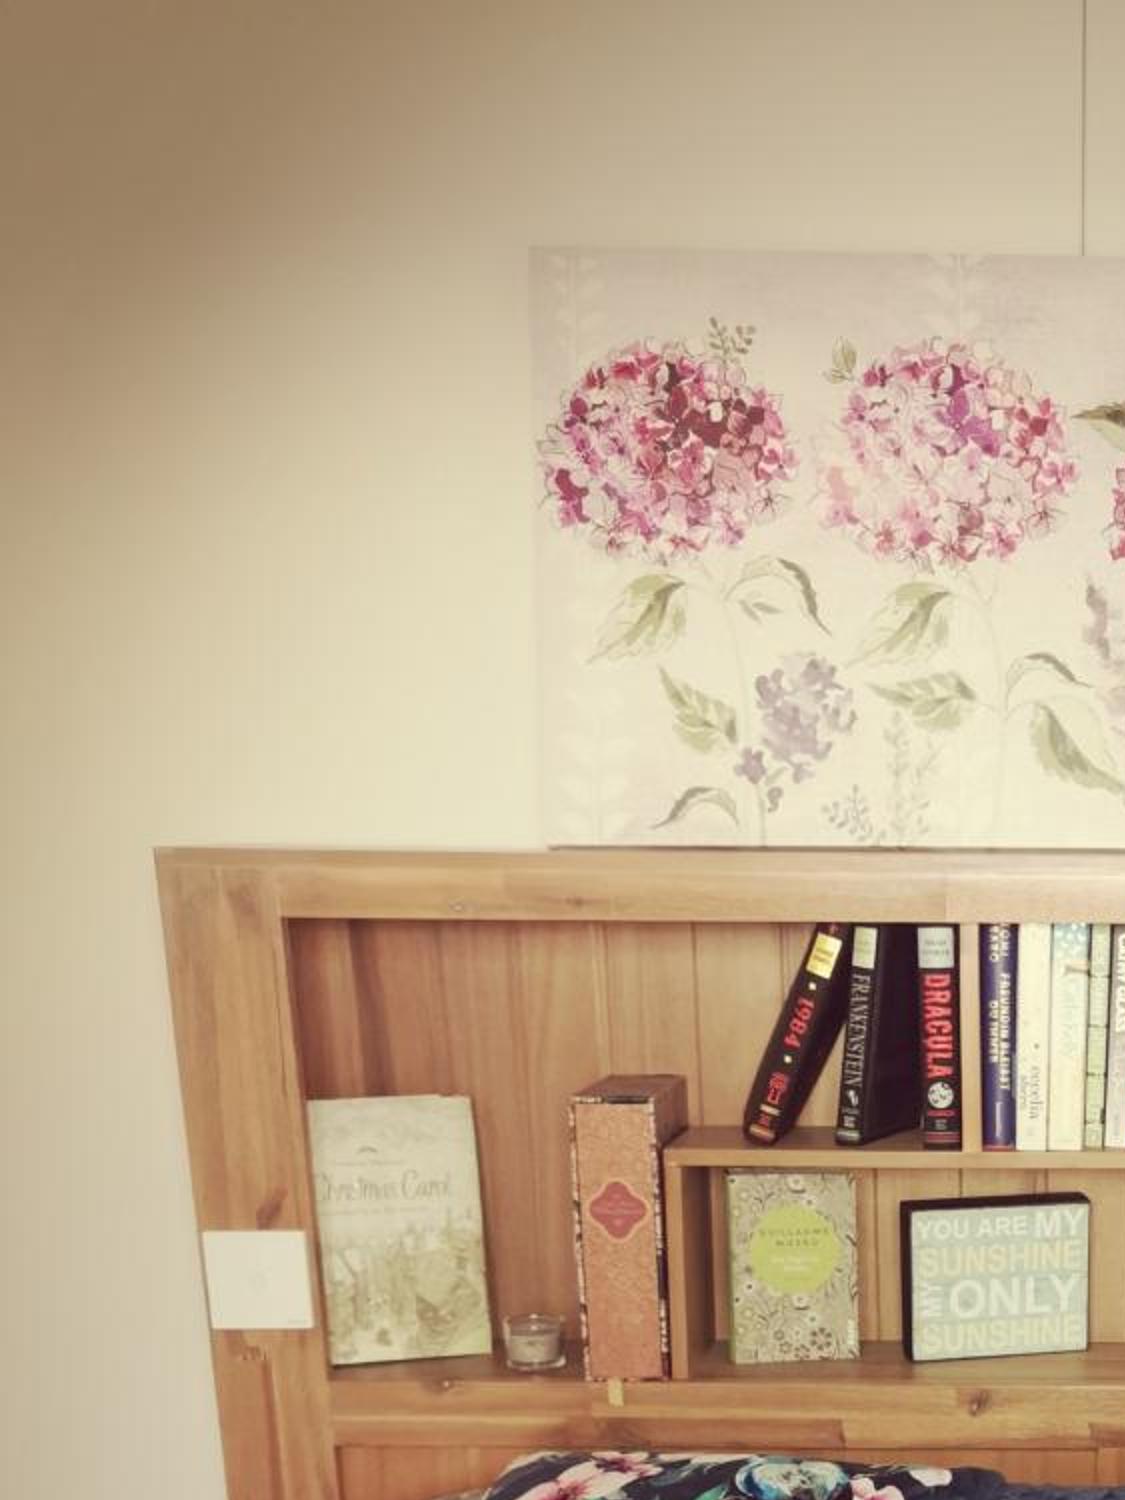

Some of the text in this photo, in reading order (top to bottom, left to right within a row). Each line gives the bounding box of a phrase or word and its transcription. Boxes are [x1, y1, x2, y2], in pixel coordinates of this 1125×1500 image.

[783, 998, 815, 1048] 1984
[843, 973, 871, 1087] FRANKENSTEIN
[923, 973, 955, 1078] DRACULA
[917, 1207, 1086, 1241] YOU ARE MY
[918, 1239, 1083, 1280] SUNSHINE
[920, 1274, 1080, 1319] MY ONLY
[920, 1315, 1082, 1354] SUNSHINE
